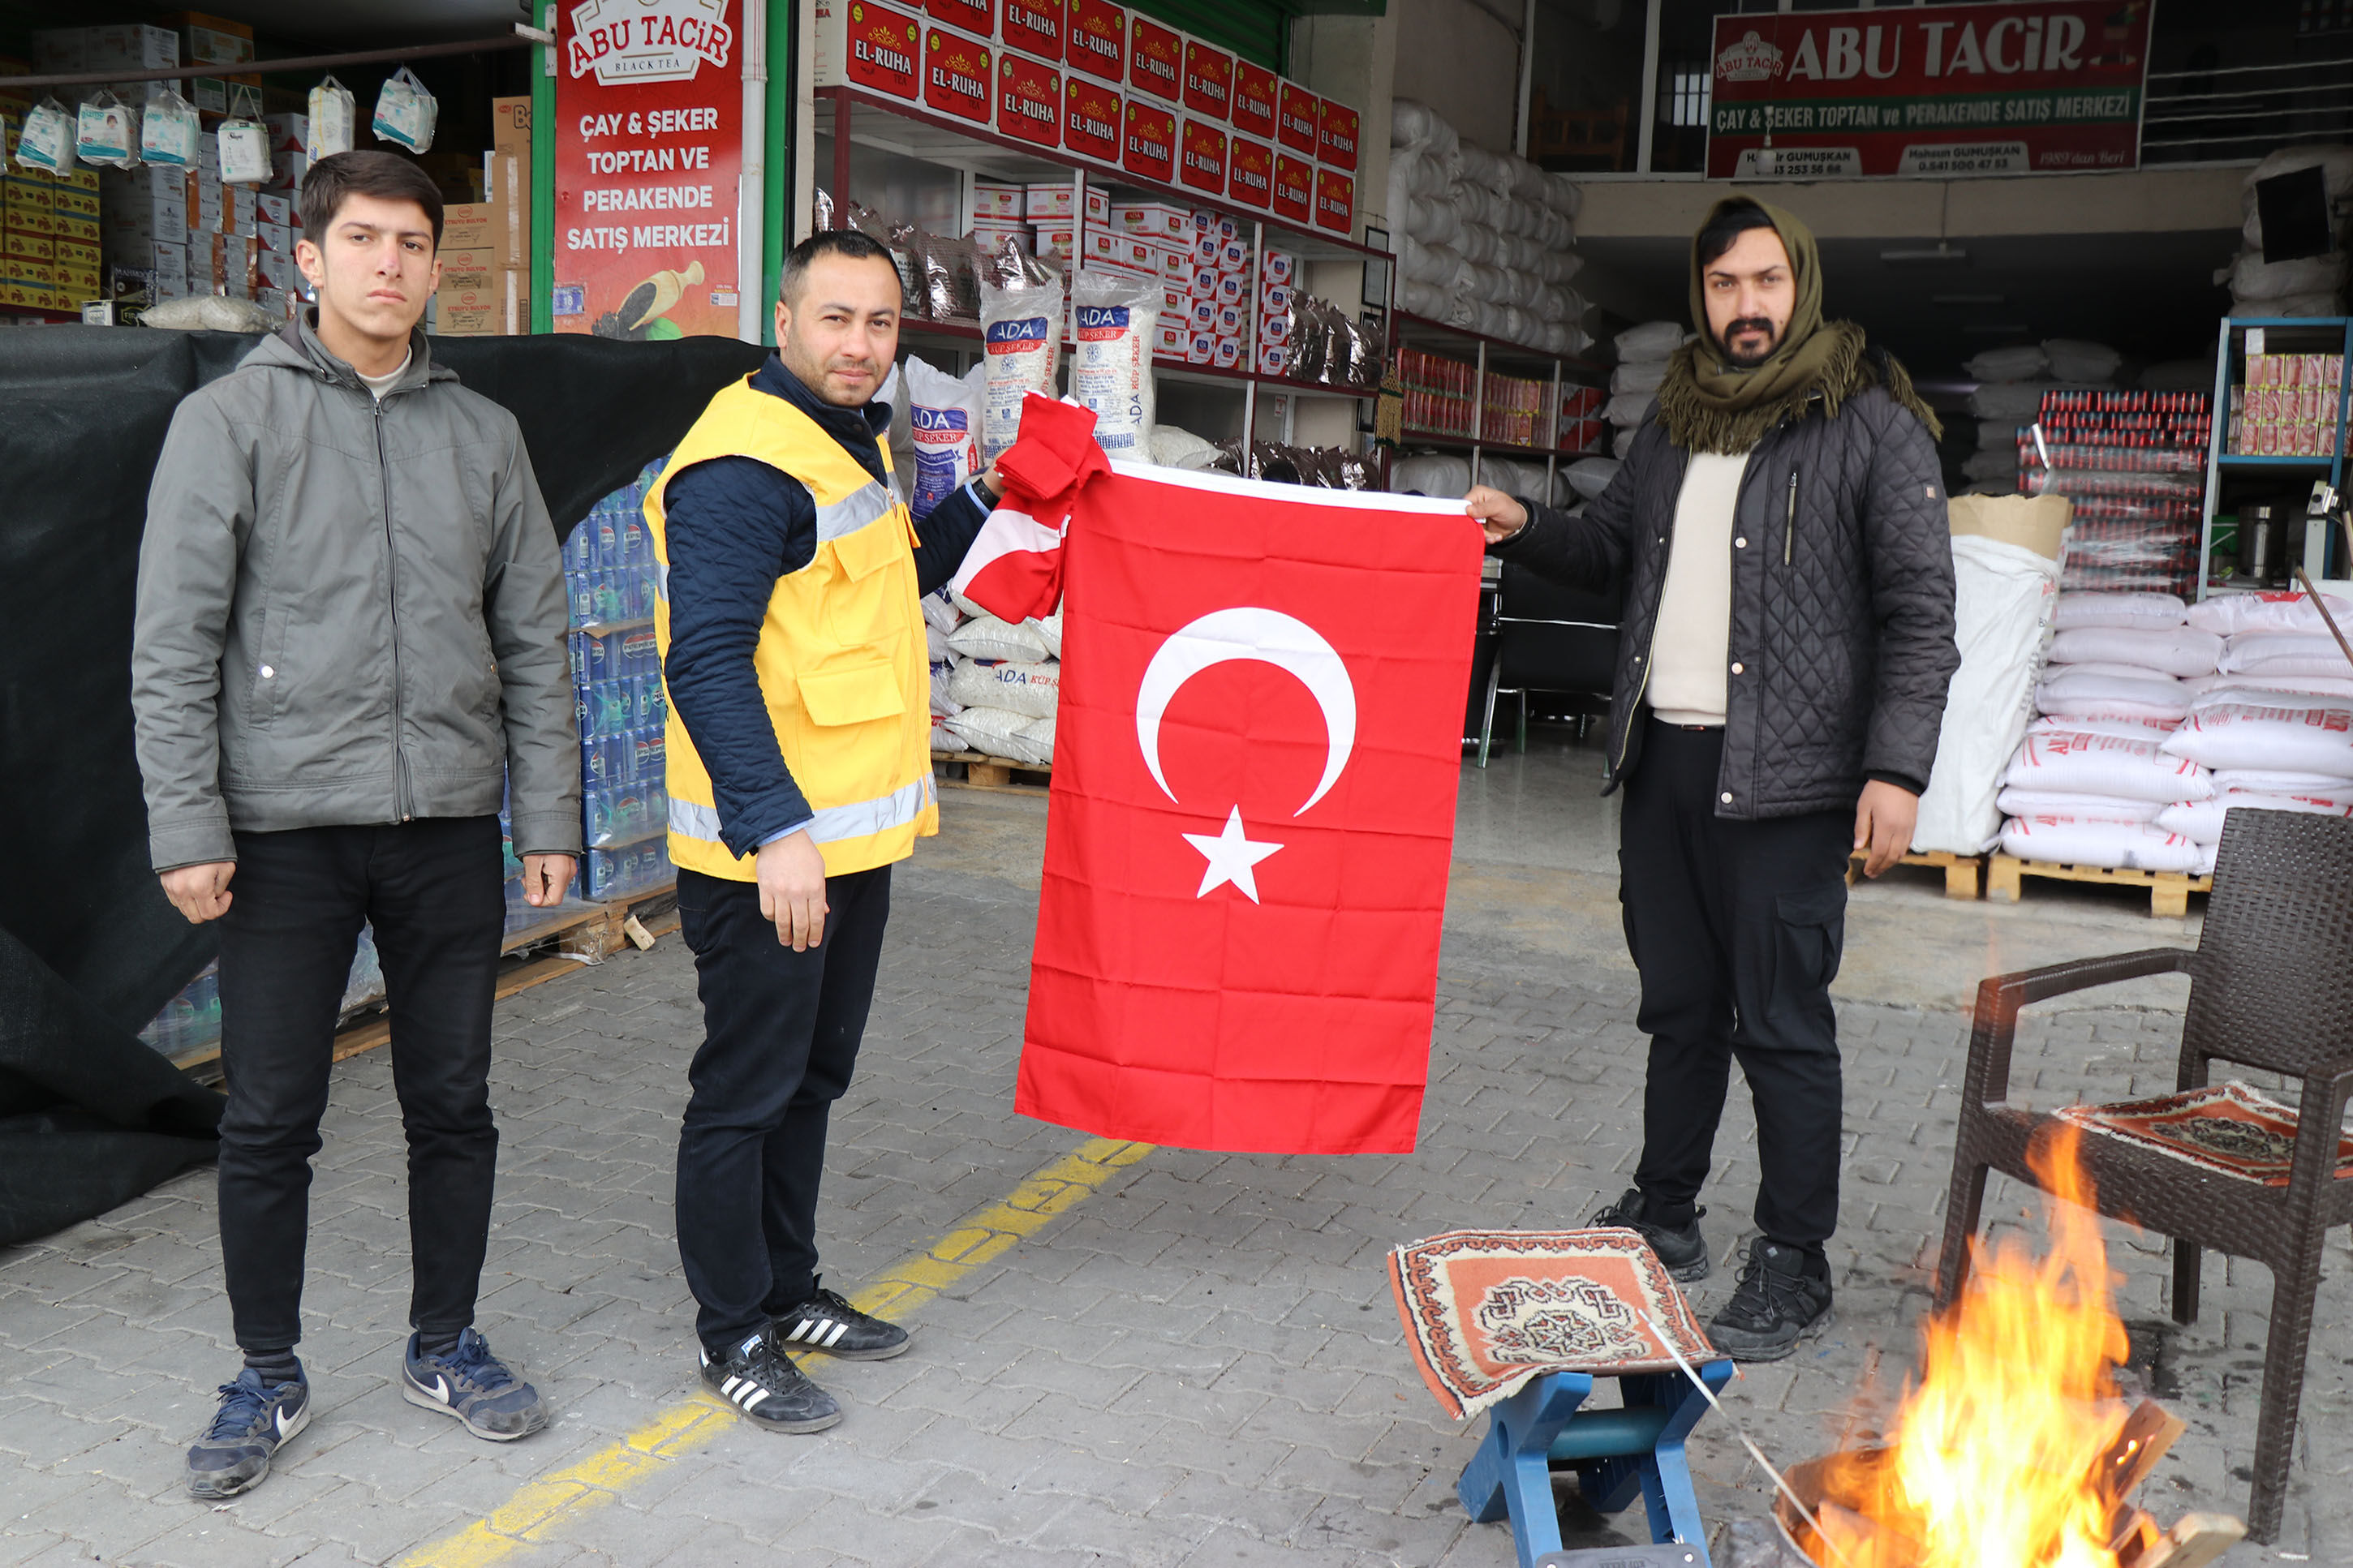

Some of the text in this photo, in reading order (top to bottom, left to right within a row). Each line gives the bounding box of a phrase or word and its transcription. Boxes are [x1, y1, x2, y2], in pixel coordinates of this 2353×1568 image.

[1009, 4, 1056, 38] EL-RUHA
[573, 19, 630, 72] ABU
[855, 39, 912, 75] EL-RUHA
[1073, 28, 1119, 60] EL-RUHA
[1787, 24, 1902, 82] ABU
[615, 58, 681, 71] BLACK TEA
[1136, 51, 1176, 82] EL-RUHA
[1719, 58, 1742, 75] ABU
[932, 67, 985, 100] EL-RUHA
[1189, 74, 1226, 101] EL-RUHA
[1004, 92, 1055, 124] EL-RUHA
[1237, 93, 1271, 119] EL-RUHA
[1716, 110, 1746, 133] ÇAY
[1749, 109, 1761, 127] &
[1817, 105, 1878, 127] TOPTAN
[1882, 108, 1900, 126] ve
[1906, 101, 2002, 125] PERAKENDE
[2004, 97, 2051, 122] SATIŞ
[2055, 90, 2130, 118] MERKEZİ
[580, 107, 718, 143] ÇAY & ŞEKER
[1070, 112, 1115, 142] EL-RUHA
[1283, 112, 1314, 137] EL-RUHA
[1129, 135, 1168, 162] EL-RUHA
[1321, 130, 1353, 153] EL-RUHA
[587, 147, 709, 174] TOPTAN VE
[1185, 151, 1220, 176] EL-RUHA
[1233, 167, 1267, 190] EL-RUHA
[583, 186, 713, 212] PERAKENDE
[1278, 183, 1307, 205] EL-RUHA
[1319, 196, 1349, 217] EL-RUHA
[567, 217, 729, 254] SATIŞ MERKEZİ
[995, 321, 1034, 340] ADA
[1081, 309, 1116, 325] ADA
[914, 410, 950, 429] ADA
[1129, 394, 1142, 427] ADA
[995, 669, 1026, 685] ADA
